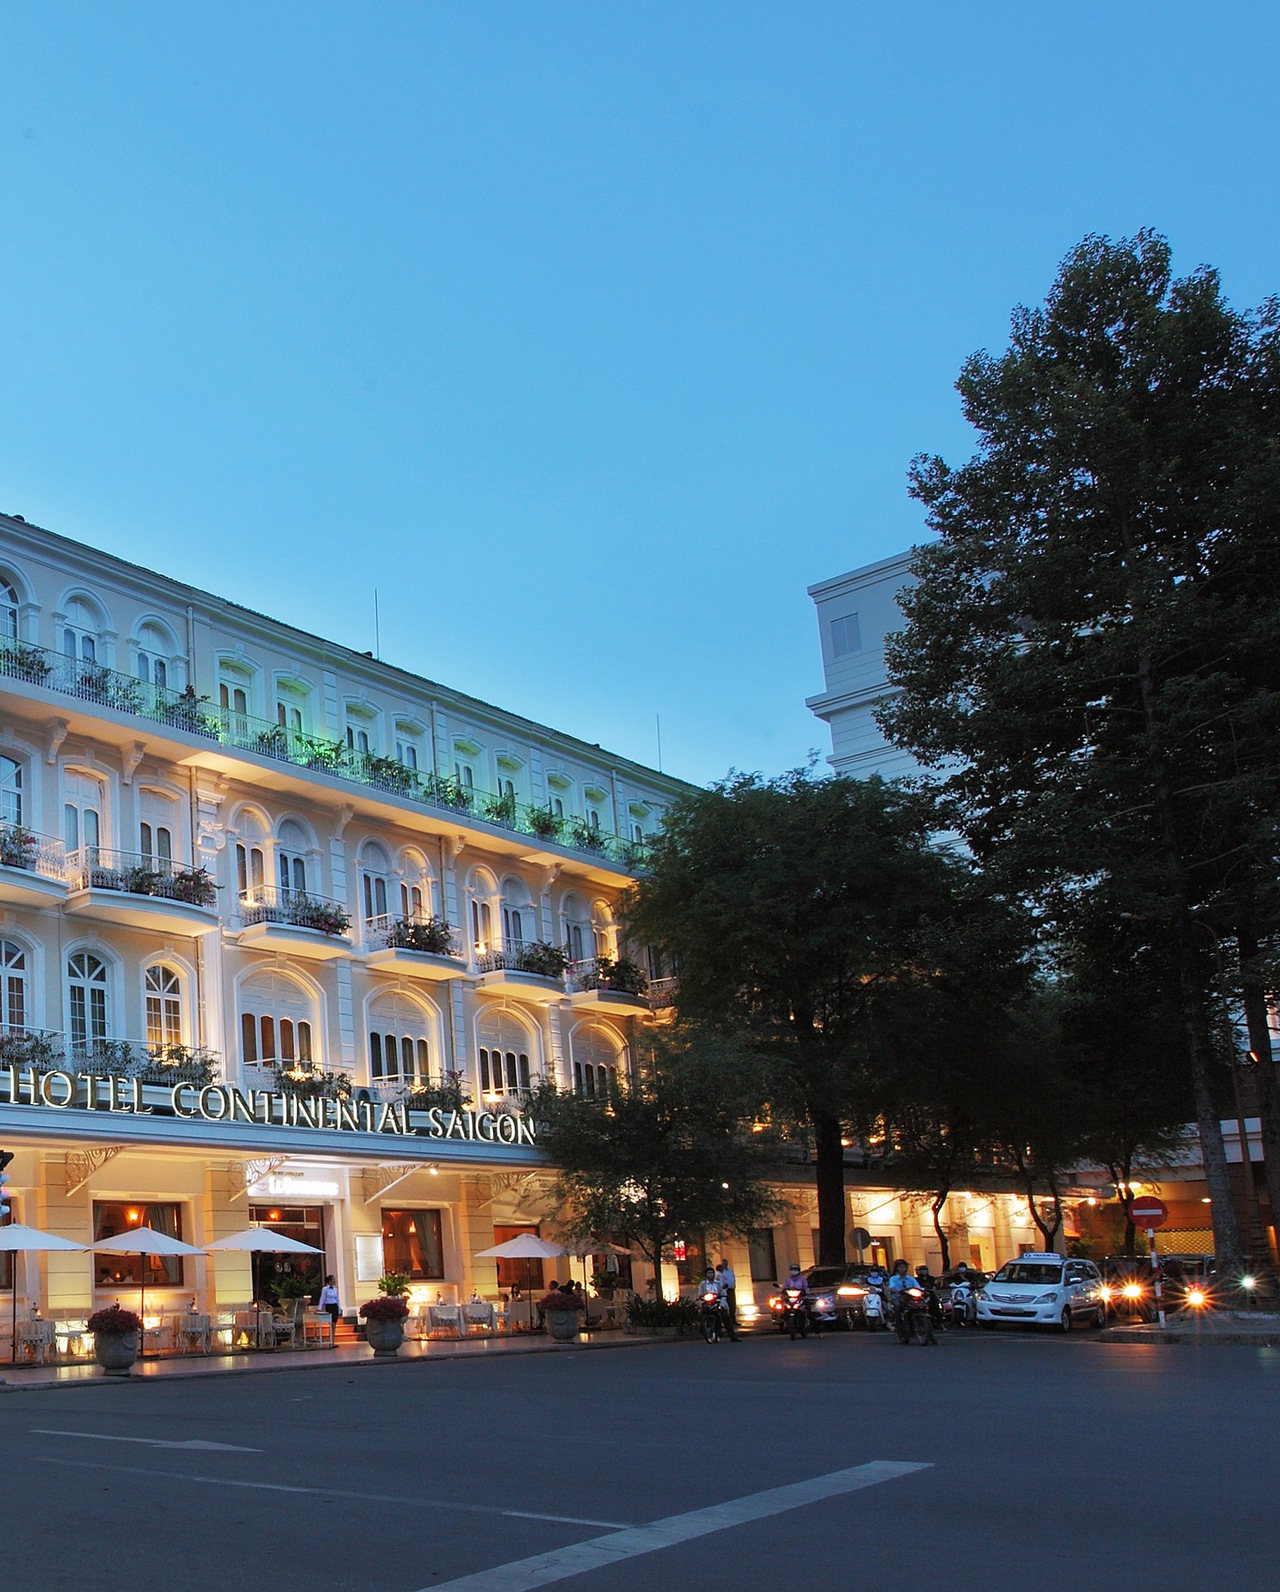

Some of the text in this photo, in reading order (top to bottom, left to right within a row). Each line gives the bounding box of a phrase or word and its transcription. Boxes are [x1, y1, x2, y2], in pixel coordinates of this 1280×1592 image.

[9, 1065, 538, 1146] HOTEL CONTINENTAL SAIGON
